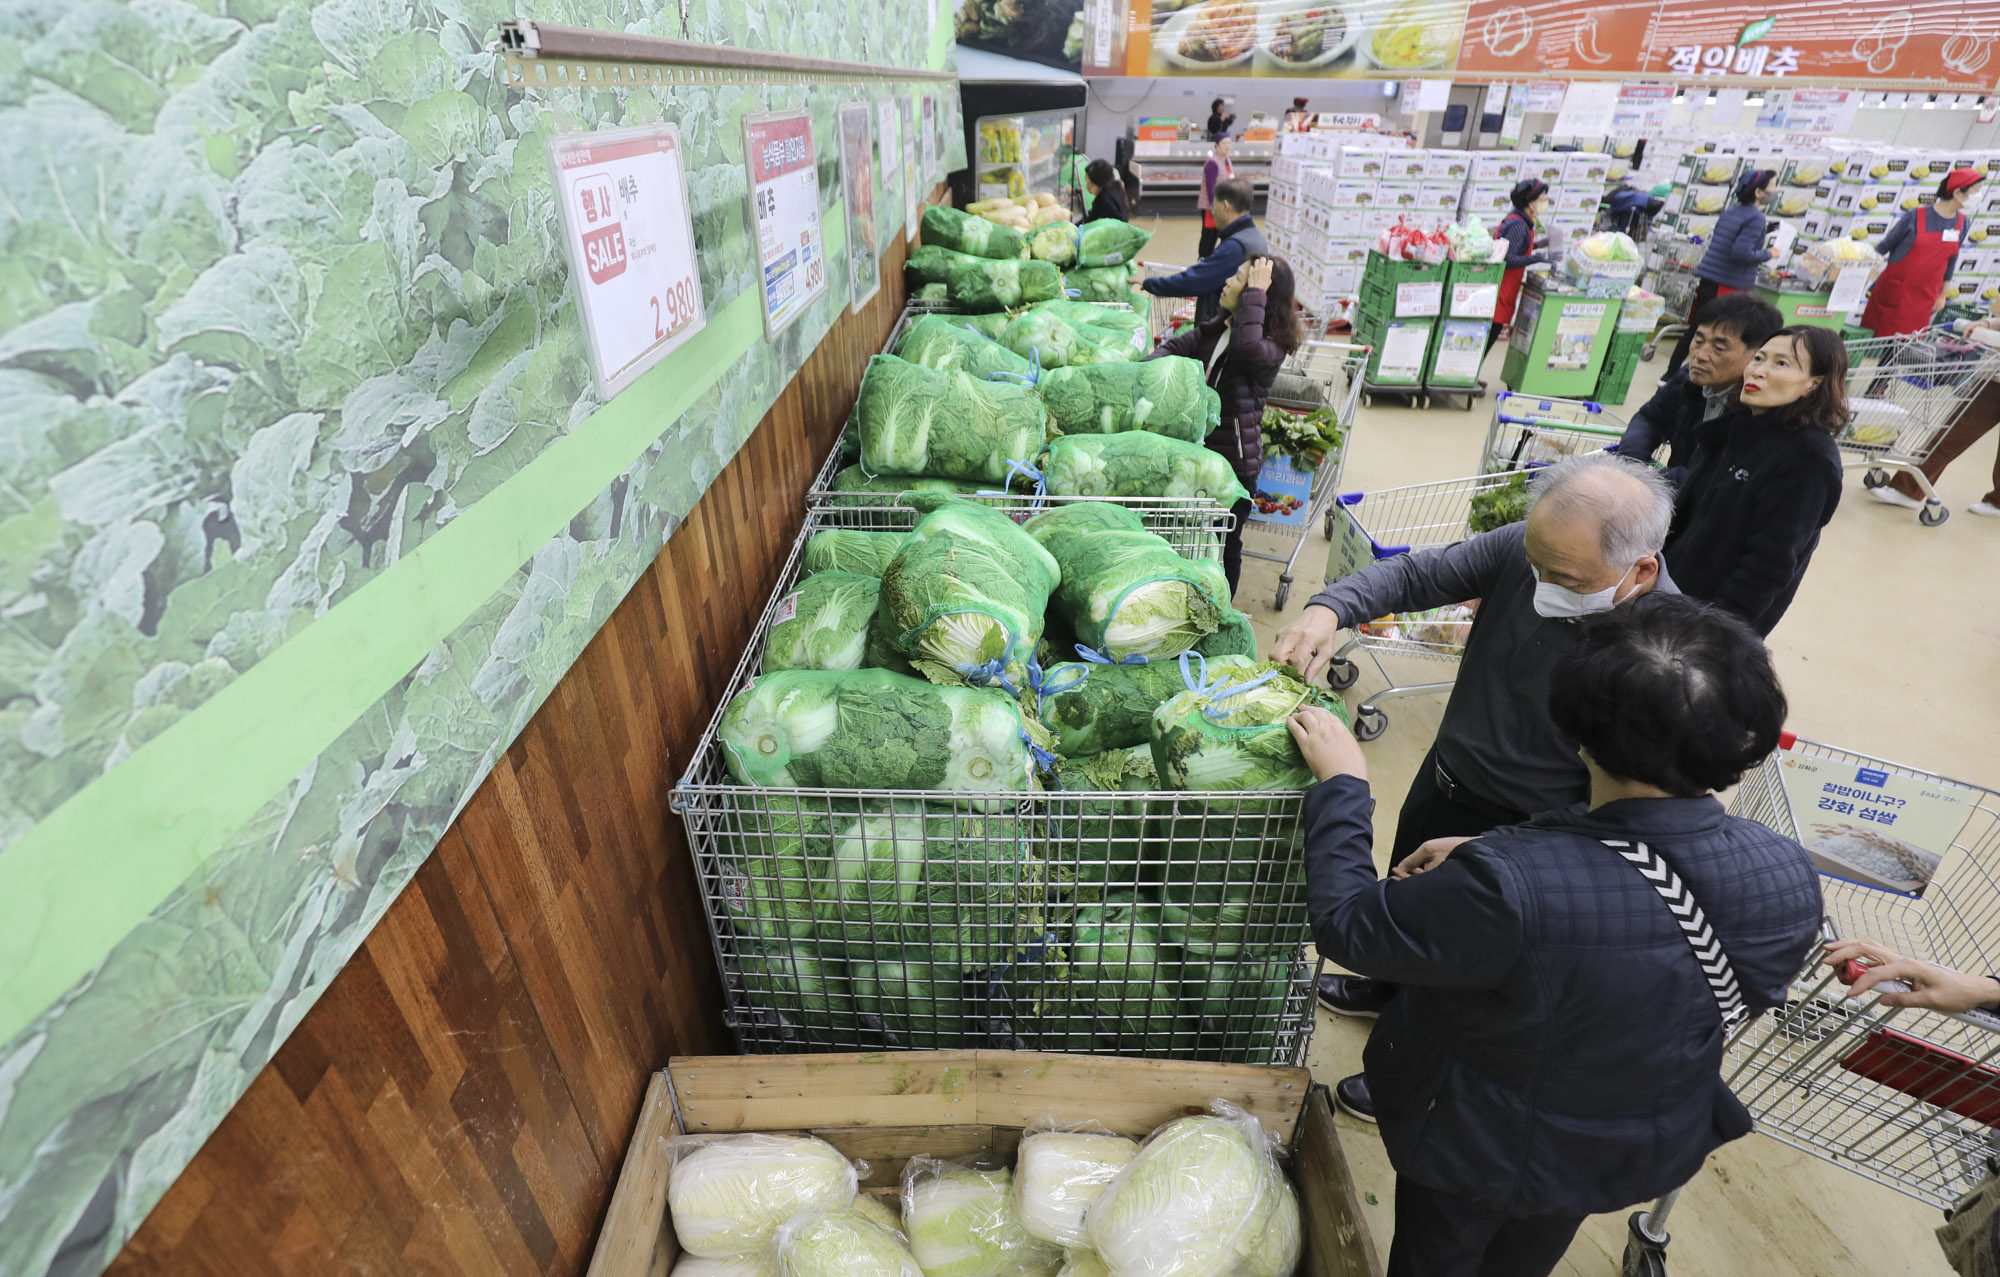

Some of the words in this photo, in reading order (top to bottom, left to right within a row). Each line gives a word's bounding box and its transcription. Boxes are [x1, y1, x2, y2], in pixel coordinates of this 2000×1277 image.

[1667, 45, 1800, 77] 절임배추
[580, 185, 611, 223] 행사
[618, 175, 638, 203] 배추
[757, 187, 775, 219] 배추
[588, 232, 625, 273] SALE
[806, 258, 823, 292] 4,980
[650, 275, 695, 340] 2,980
[1266, 470, 1306, 486] 우리과일
[1818, 796, 1854, 816] 강화
[1859, 807, 1897, 826] 섬쌀
